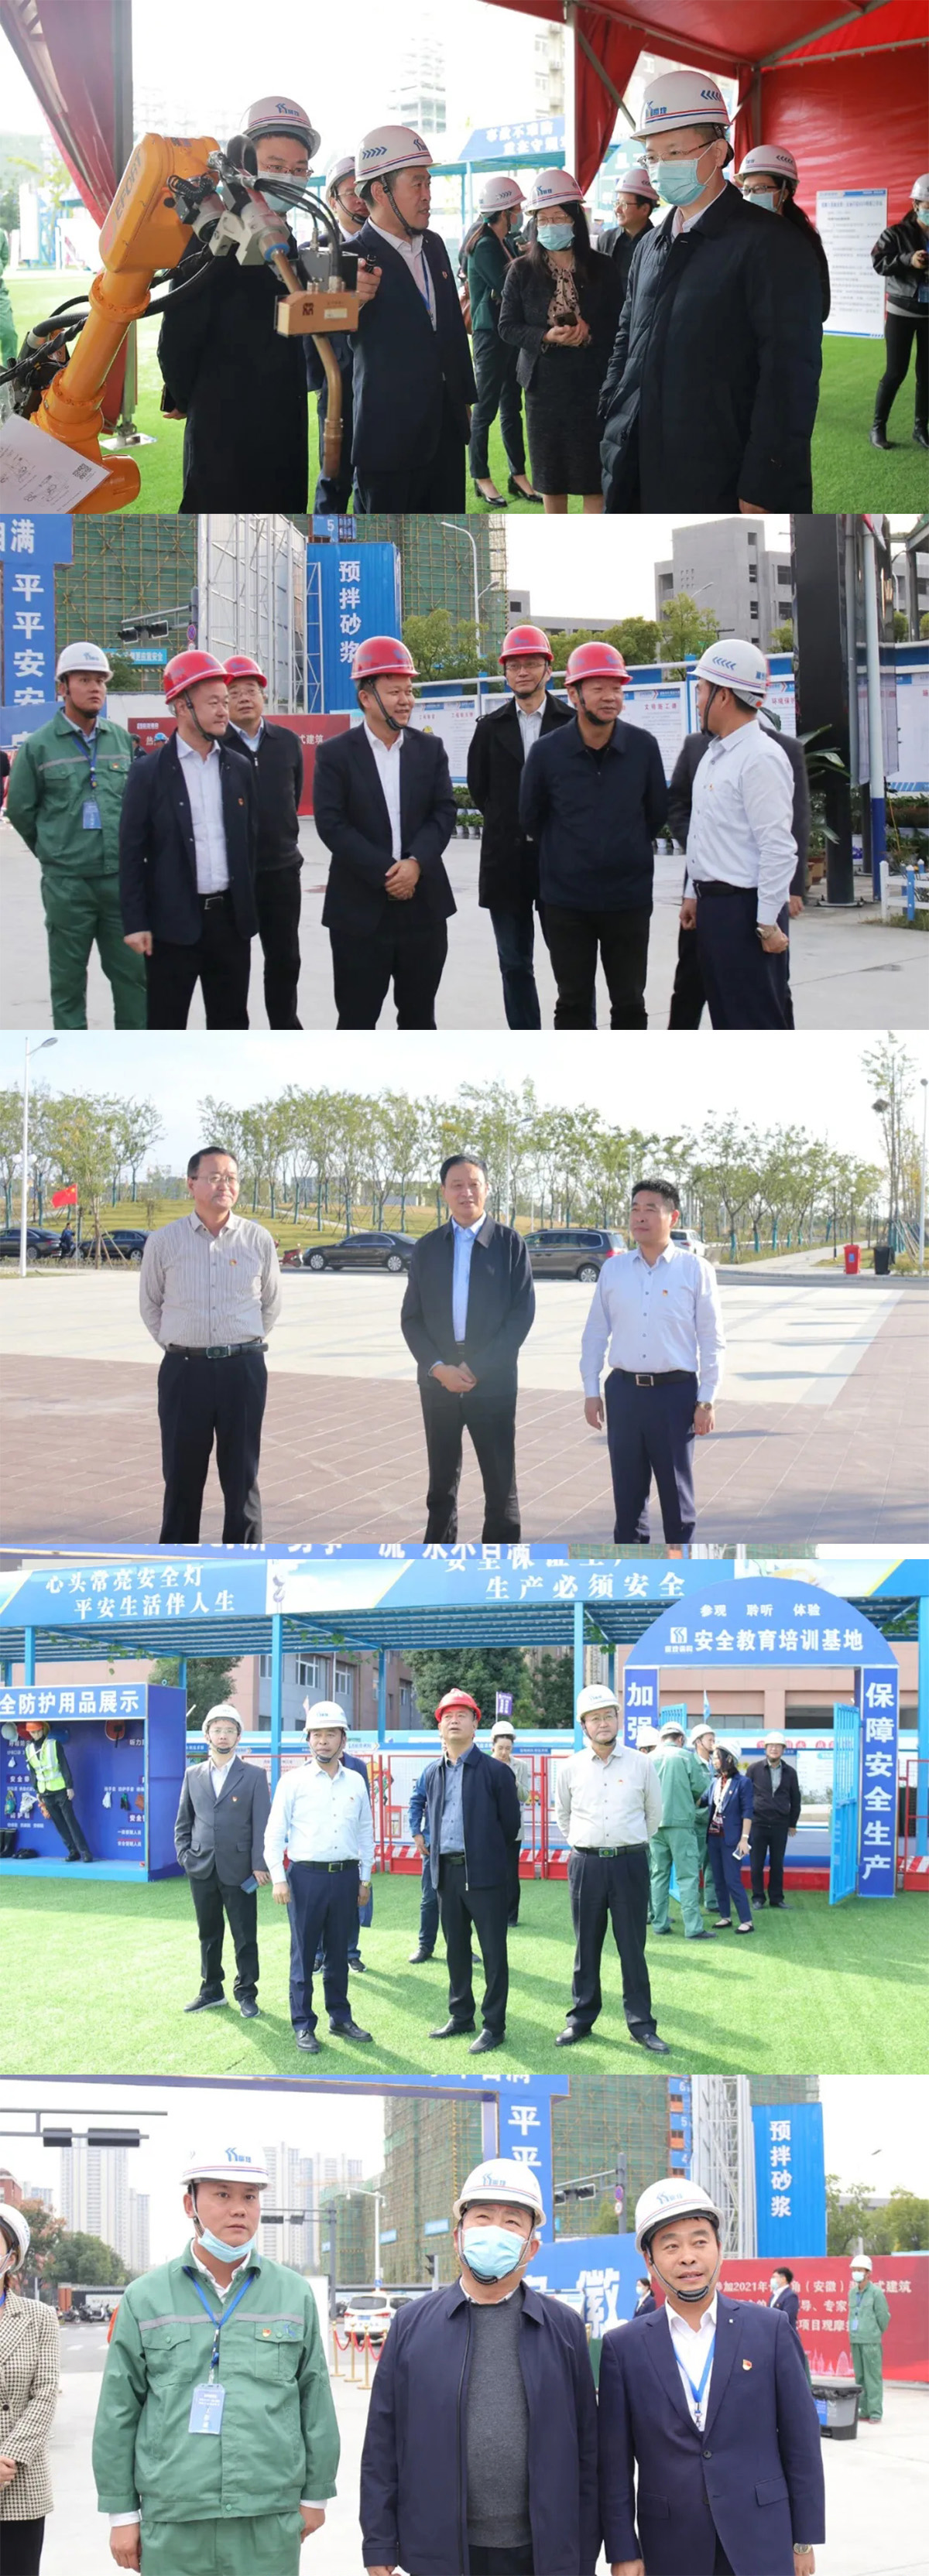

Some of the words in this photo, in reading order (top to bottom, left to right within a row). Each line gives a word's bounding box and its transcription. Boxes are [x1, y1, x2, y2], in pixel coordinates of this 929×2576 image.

[115, 145, 141, 221] EFORT
[339, 560, 362, 663] 预拌砂浆
[46, 1564, 204, 1594] 心头常亮安全灯
[485, 1572, 685, 1599] 生产必须安全
[74, 1590, 235, 1620] 平安生活伴人生
[700, 1604, 727, 1617] 参观
[746, 1604, 773, 1616] 聆听
[793, 1603, 821, 1616] 体验
[694, 1628, 863, 1651] 安全教育培训基地
[0, 1690, 139, 1715] 全防护用品展示
[862, 1682, 894, 1880] 保障安全生产
[770, 2120, 792, 2218] 预拌砂浆
